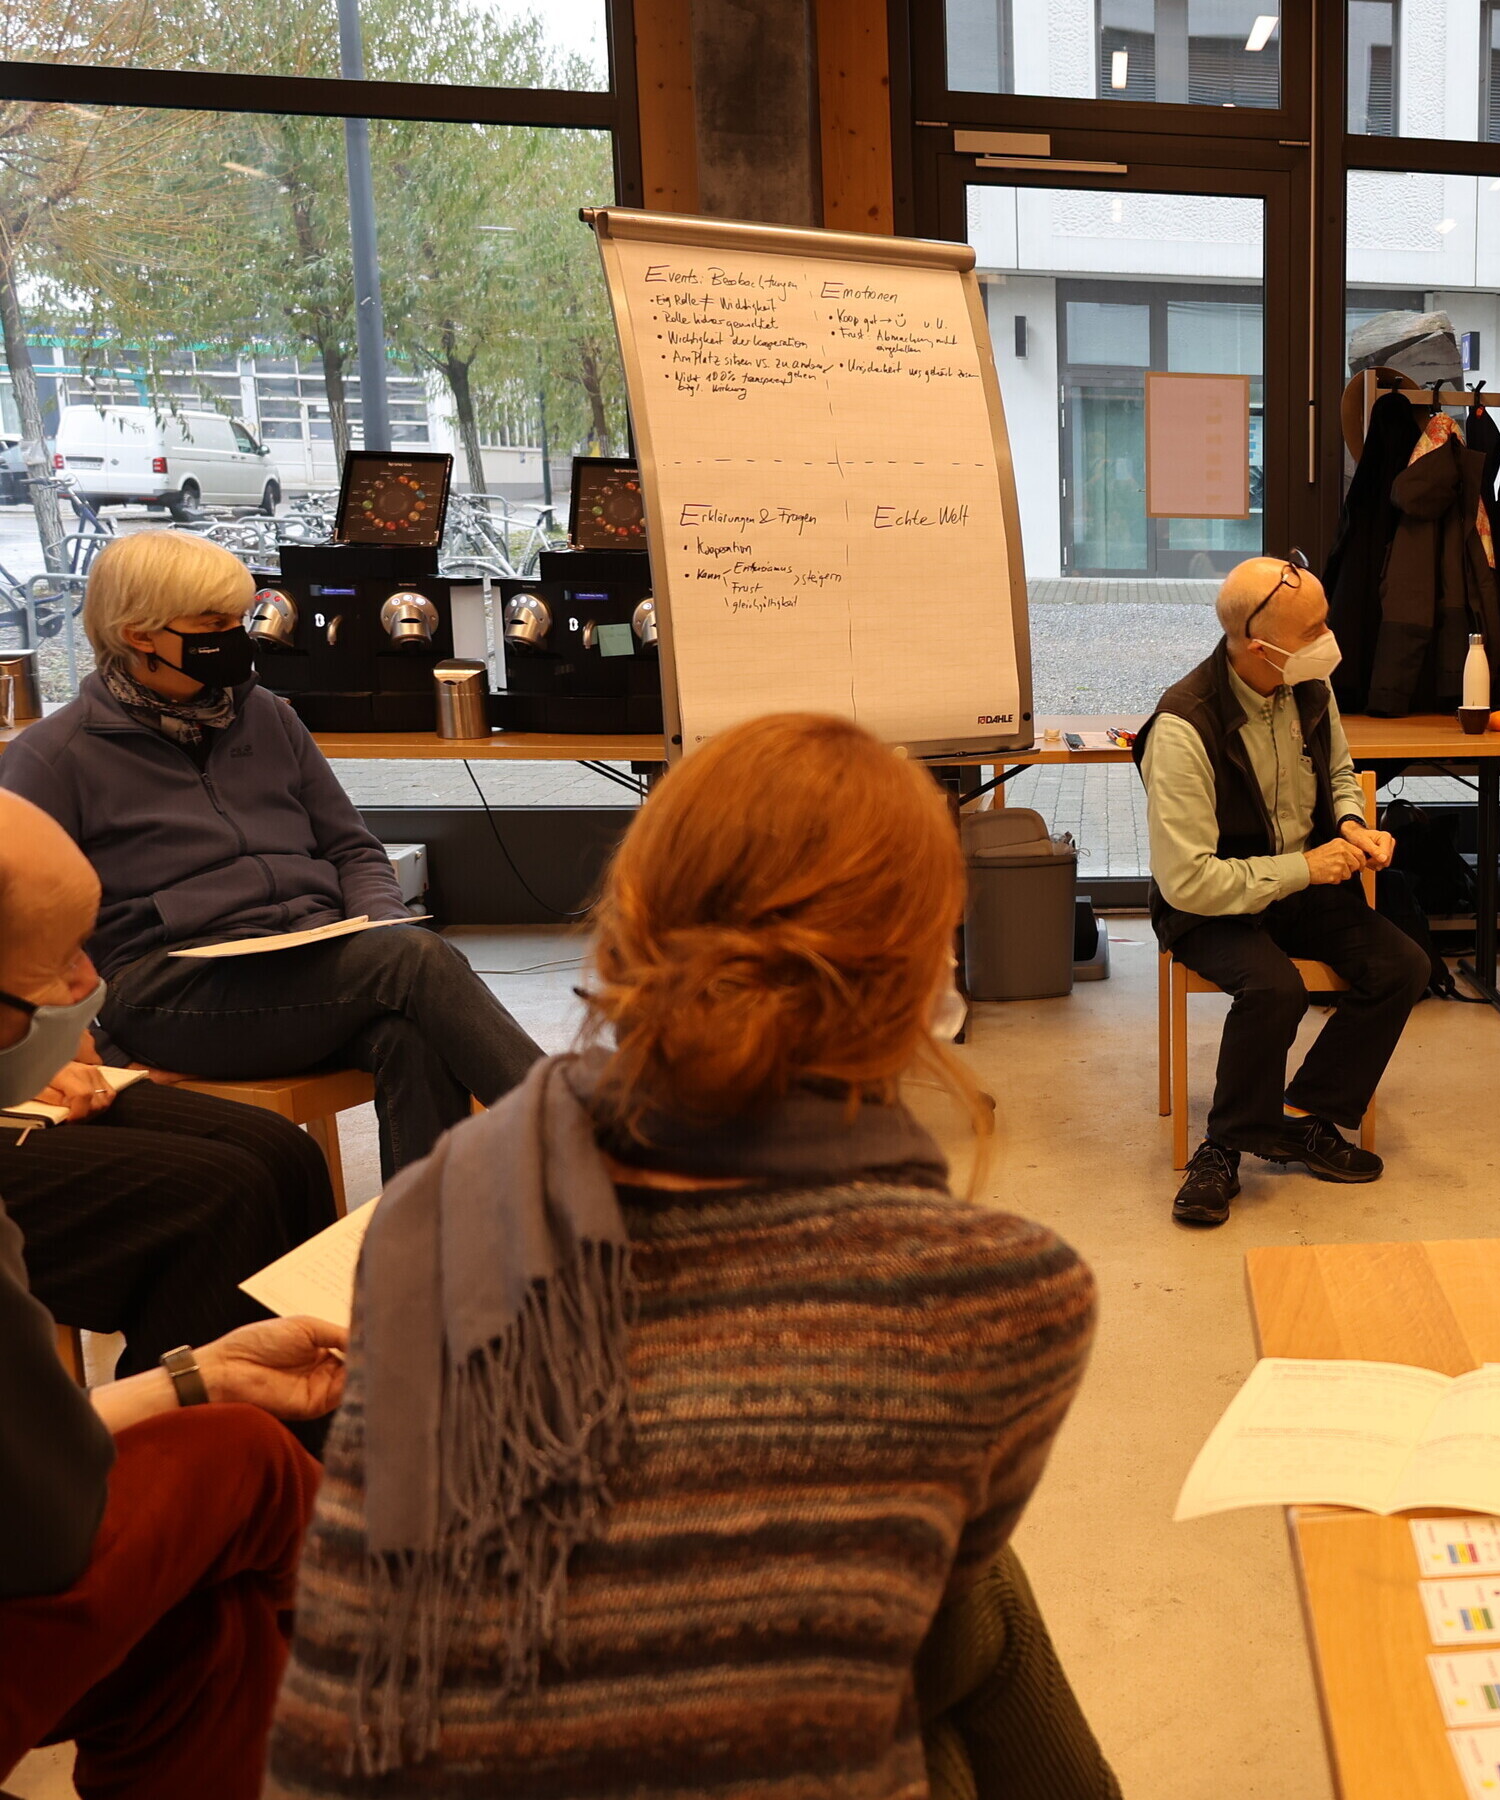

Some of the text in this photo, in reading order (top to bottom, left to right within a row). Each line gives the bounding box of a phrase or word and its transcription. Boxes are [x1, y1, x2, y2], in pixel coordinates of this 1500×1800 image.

[821, 281, 899, 303] Emotionen
[731, 336, 750, 347] der
[672, 349, 692, 364] Am
[691, 350, 721, 366] Platz
[705, 370, 736, 382] 100%
[680, 503, 817, 536] Erklärungen & Fragen
[873, 503, 970, 529] Echte Welt
[801, 569, 842, 587] steigern
[731, 581, 764, 595] Frust
[985, 713, 1014, 725] DAHLE
